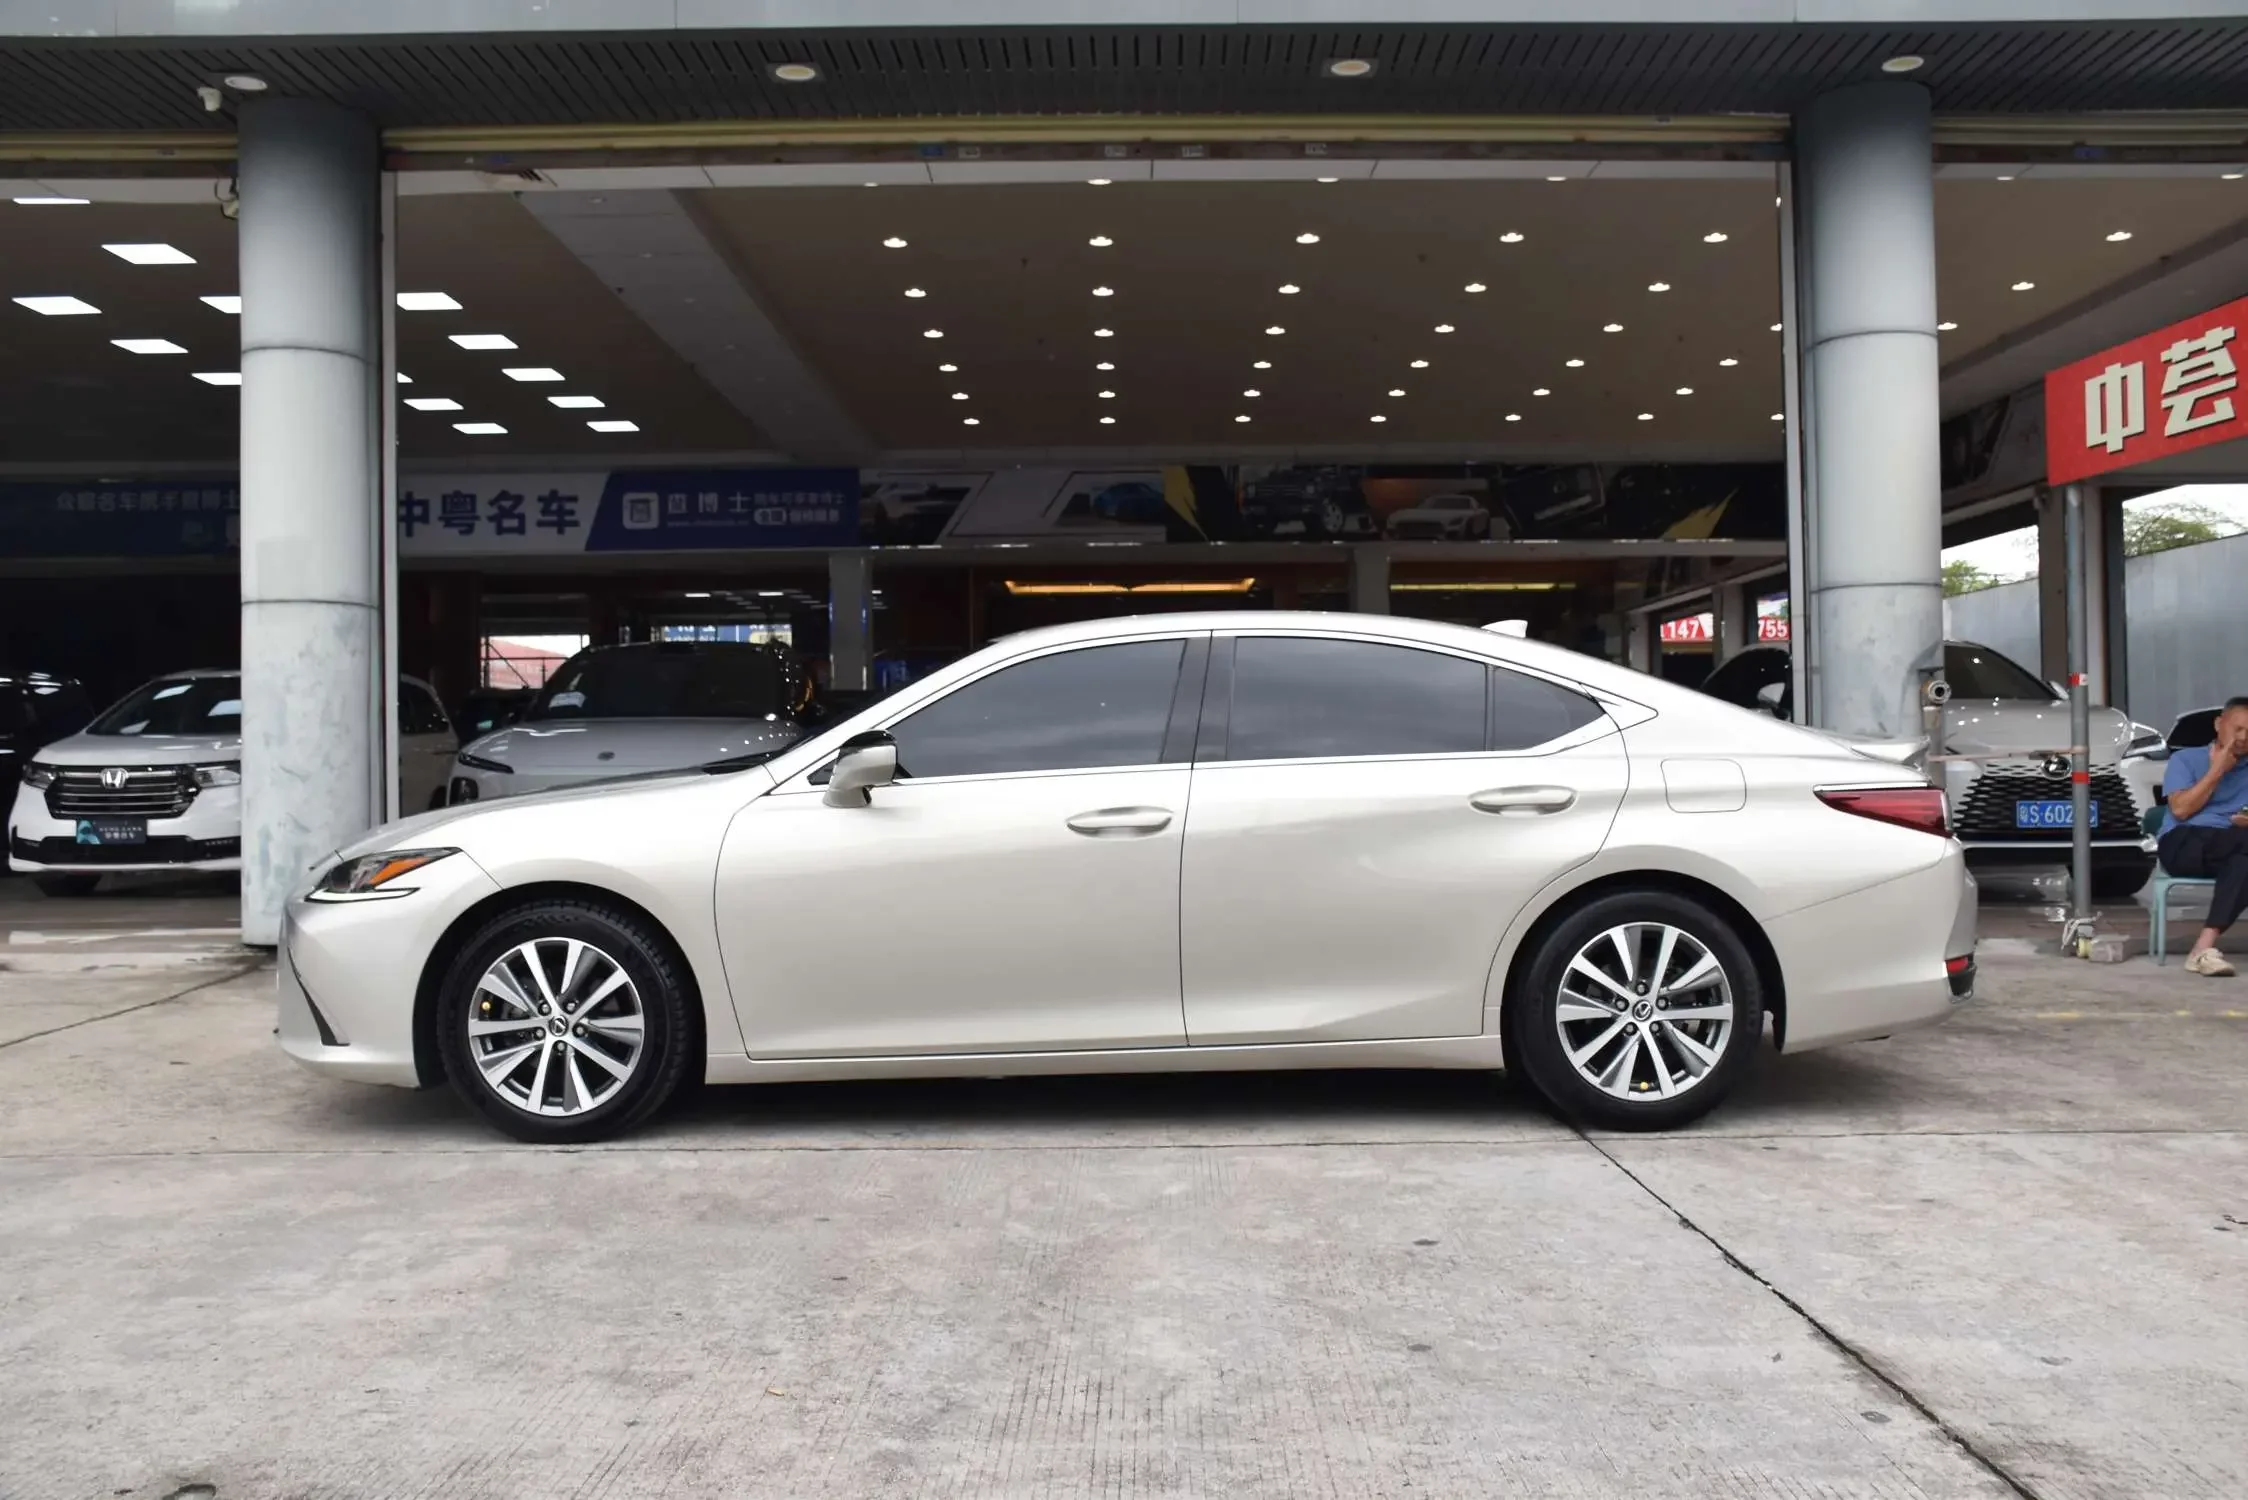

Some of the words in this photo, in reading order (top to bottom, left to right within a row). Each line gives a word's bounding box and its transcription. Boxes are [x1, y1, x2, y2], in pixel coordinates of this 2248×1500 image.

[2085, 325, 2238, 455] 中荟
[398, 488, 581, 538] 中粤名车
